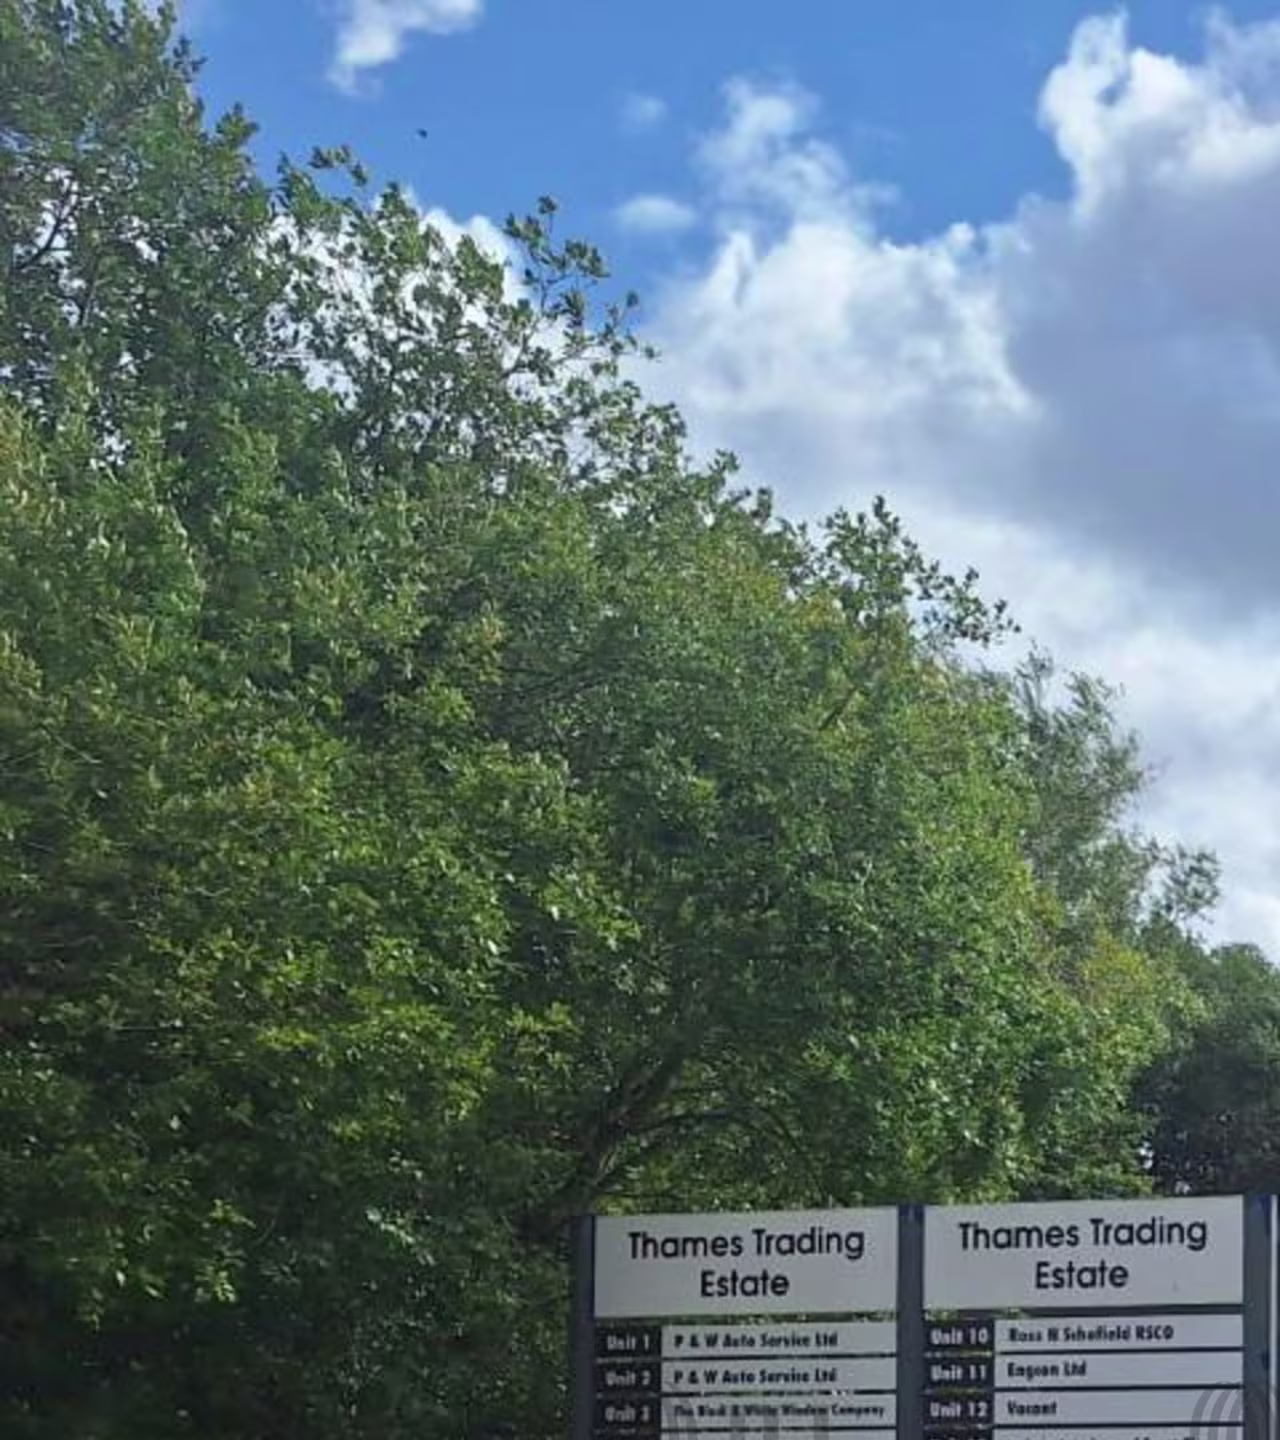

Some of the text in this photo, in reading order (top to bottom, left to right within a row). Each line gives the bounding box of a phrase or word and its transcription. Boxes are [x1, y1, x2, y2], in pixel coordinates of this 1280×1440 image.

[959, 1217, 1207, 1251] Thames Trading
[628, 1227, 865, 1259] Thames Trading
[700, 1269, 789, 1297] Estate
[1035, 1261, 1128, 1289] Estate
[675, 1331, 838, 1347] P & W Auto Service Ltd
[931, 1328, 988, 1344] Unit 10
[1009, 1328, 1041, 1341] Ross
[1063, 1325, 1130, 1341] Schofield
[607, 1335, 649, 1350] Unit 1
[674, 1367, 837, 1383] P & W Auto Service Ltd
[931, 1363, 987, 1380] Unit 11
[1063, 1361, 1086, 1376] Ltd
[606, 1370, 650, 1386] Unit 2
[605, 1406, 636, 1421] Unit
[674, 1405, 693, 1417] The
[832, 1403, 885, 1419] Company
[930, 1401, 988, 1417] Unit 12
[1007, 1401, 1057, 1416] Vacant
